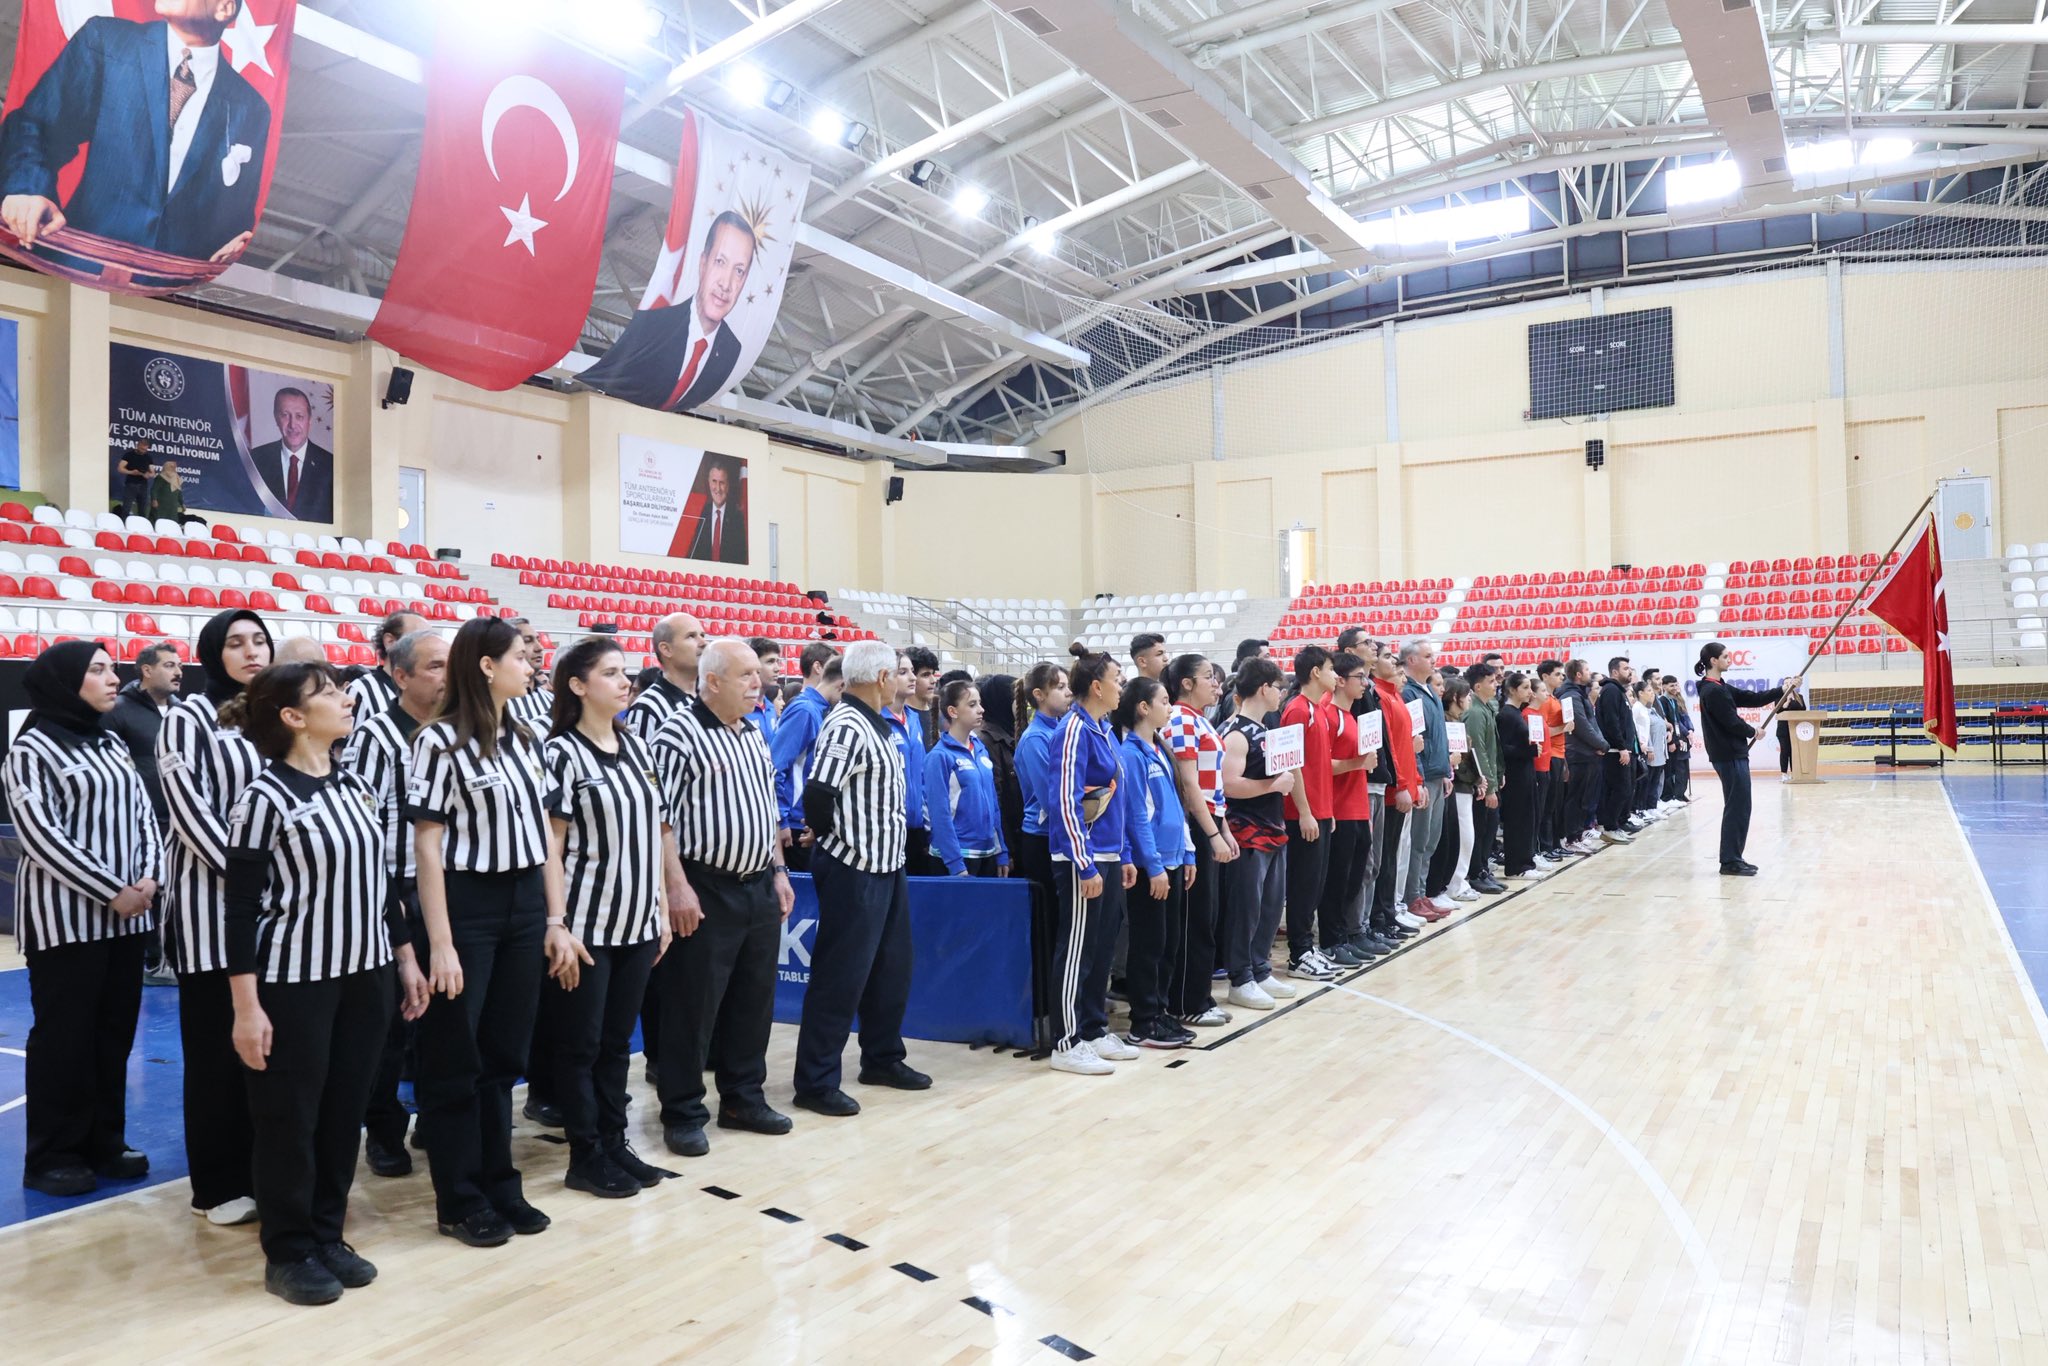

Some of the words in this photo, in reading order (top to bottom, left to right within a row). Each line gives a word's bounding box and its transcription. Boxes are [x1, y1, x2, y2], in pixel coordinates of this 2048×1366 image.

[1610, 340, 1626, 349] SCORE
[118, 407, 146, 422] TÜM
[149, 413, 212, 433] ANTRENÖR
[123, 424, 224, 450] SPORCULARIMIZA
[166, 445, 220, 461] DİLİYORUM
[778, 970, 810, 983] TABLE
